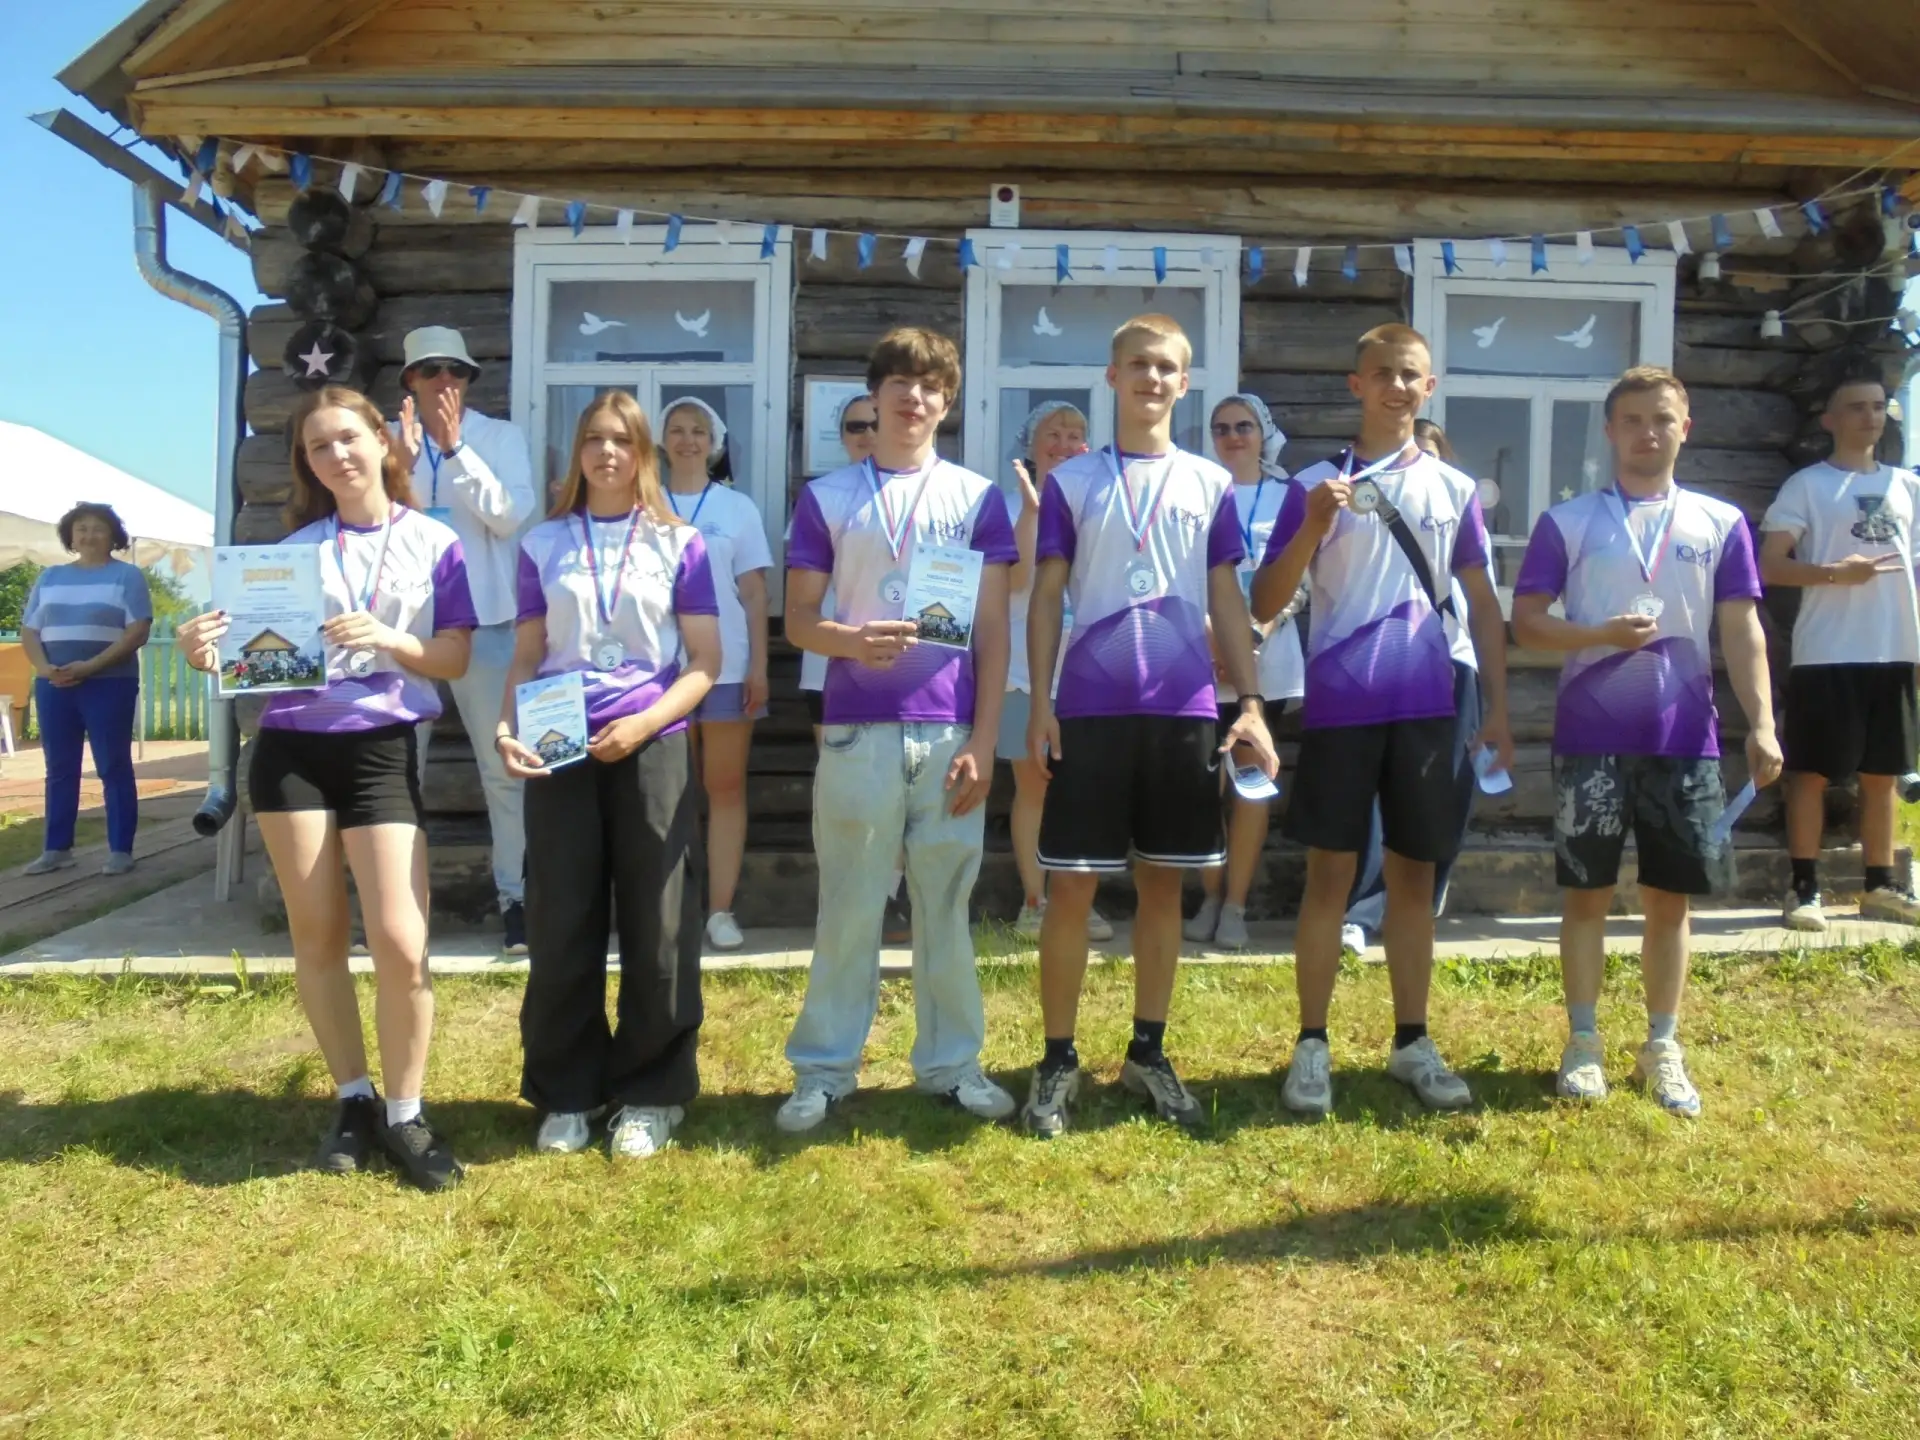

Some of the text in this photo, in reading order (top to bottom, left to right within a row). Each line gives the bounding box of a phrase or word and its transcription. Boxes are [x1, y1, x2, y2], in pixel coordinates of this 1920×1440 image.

[1139, 580, 1146, 590] 2
[892, 590, 900, 601] 2
[606, 655, 615, 666] 2
[359, 662, 367, 673] 2
